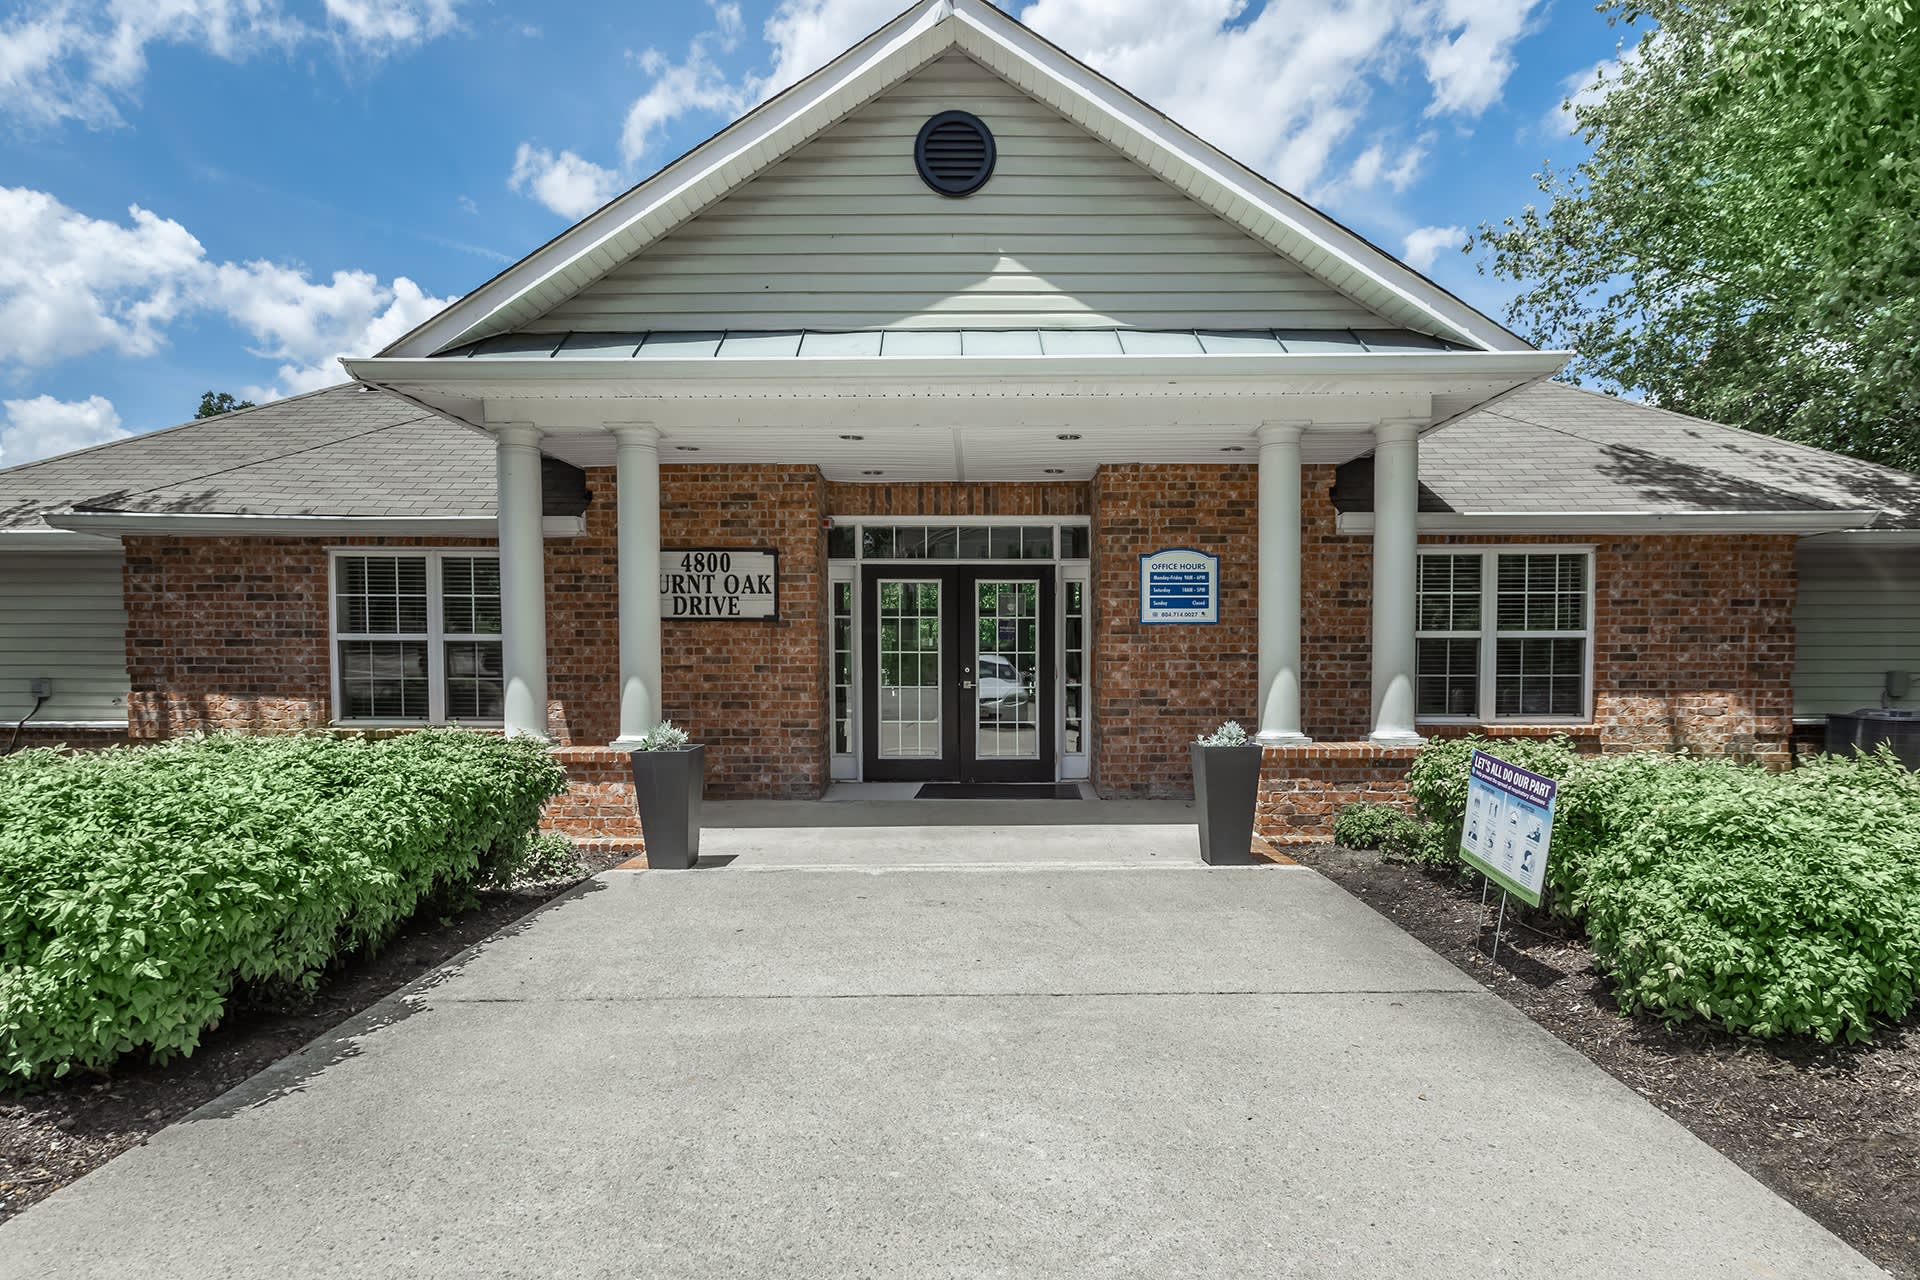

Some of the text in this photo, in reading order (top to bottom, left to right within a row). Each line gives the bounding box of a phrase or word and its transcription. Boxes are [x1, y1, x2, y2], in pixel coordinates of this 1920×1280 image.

[681, 552, 731, 573] 4800
[660, 574, 772, 594] URNT OAK
[673, 595, 740, 616] DRIVE
[1474, 755, 1492, 773] LET'S
[1490, 763, 1503, 778] ALL
[1502, 768, 1513, 783] DO
[1513, 772, 1530, 790] OUR
[1529, 779, 1552, 798] PART
